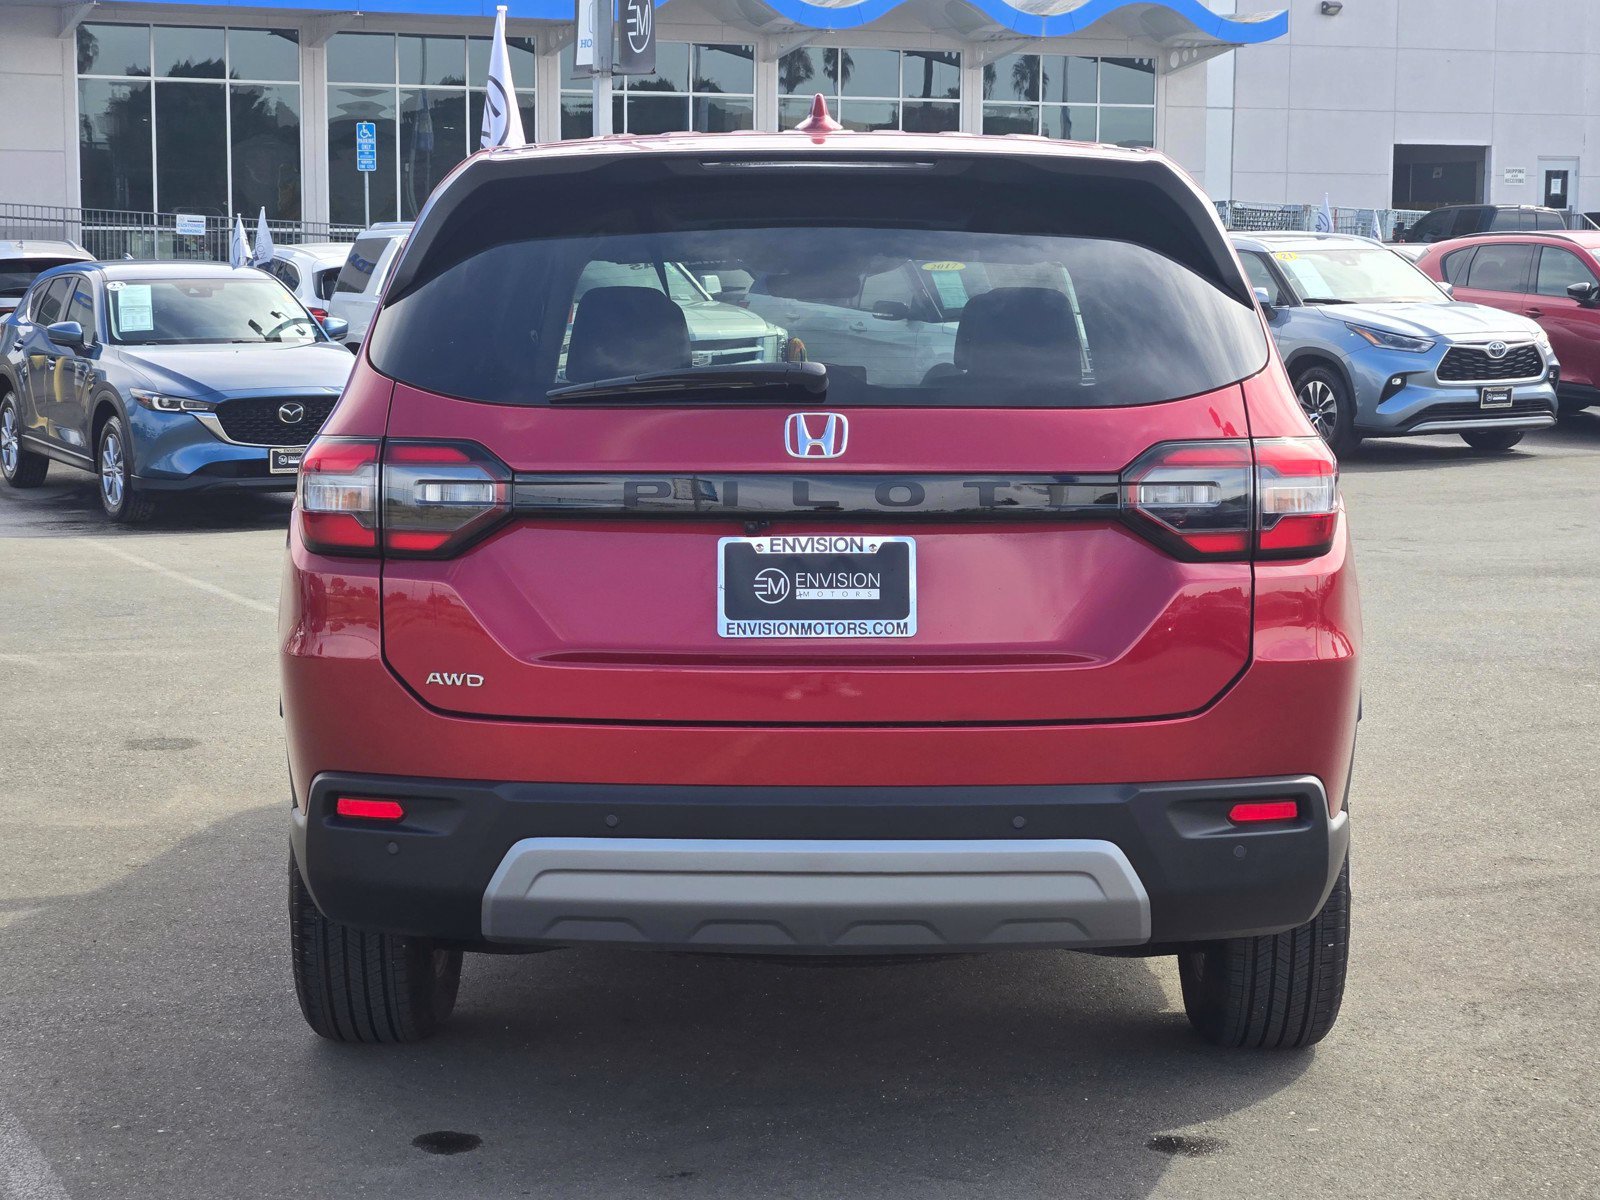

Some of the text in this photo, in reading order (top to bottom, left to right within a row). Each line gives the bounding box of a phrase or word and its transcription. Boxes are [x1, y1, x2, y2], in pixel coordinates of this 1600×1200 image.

[623, 480, 1011, 507] PILOT
[769, 537, 864, 553] ENVISION
[795, 572, 881, 588] ENVISION
[802, 590, 873, 598] MOTORS
[726, 621, 909, 636] ENVISIONMOTORS.COM
[425, 672, 485, 687] AWD
